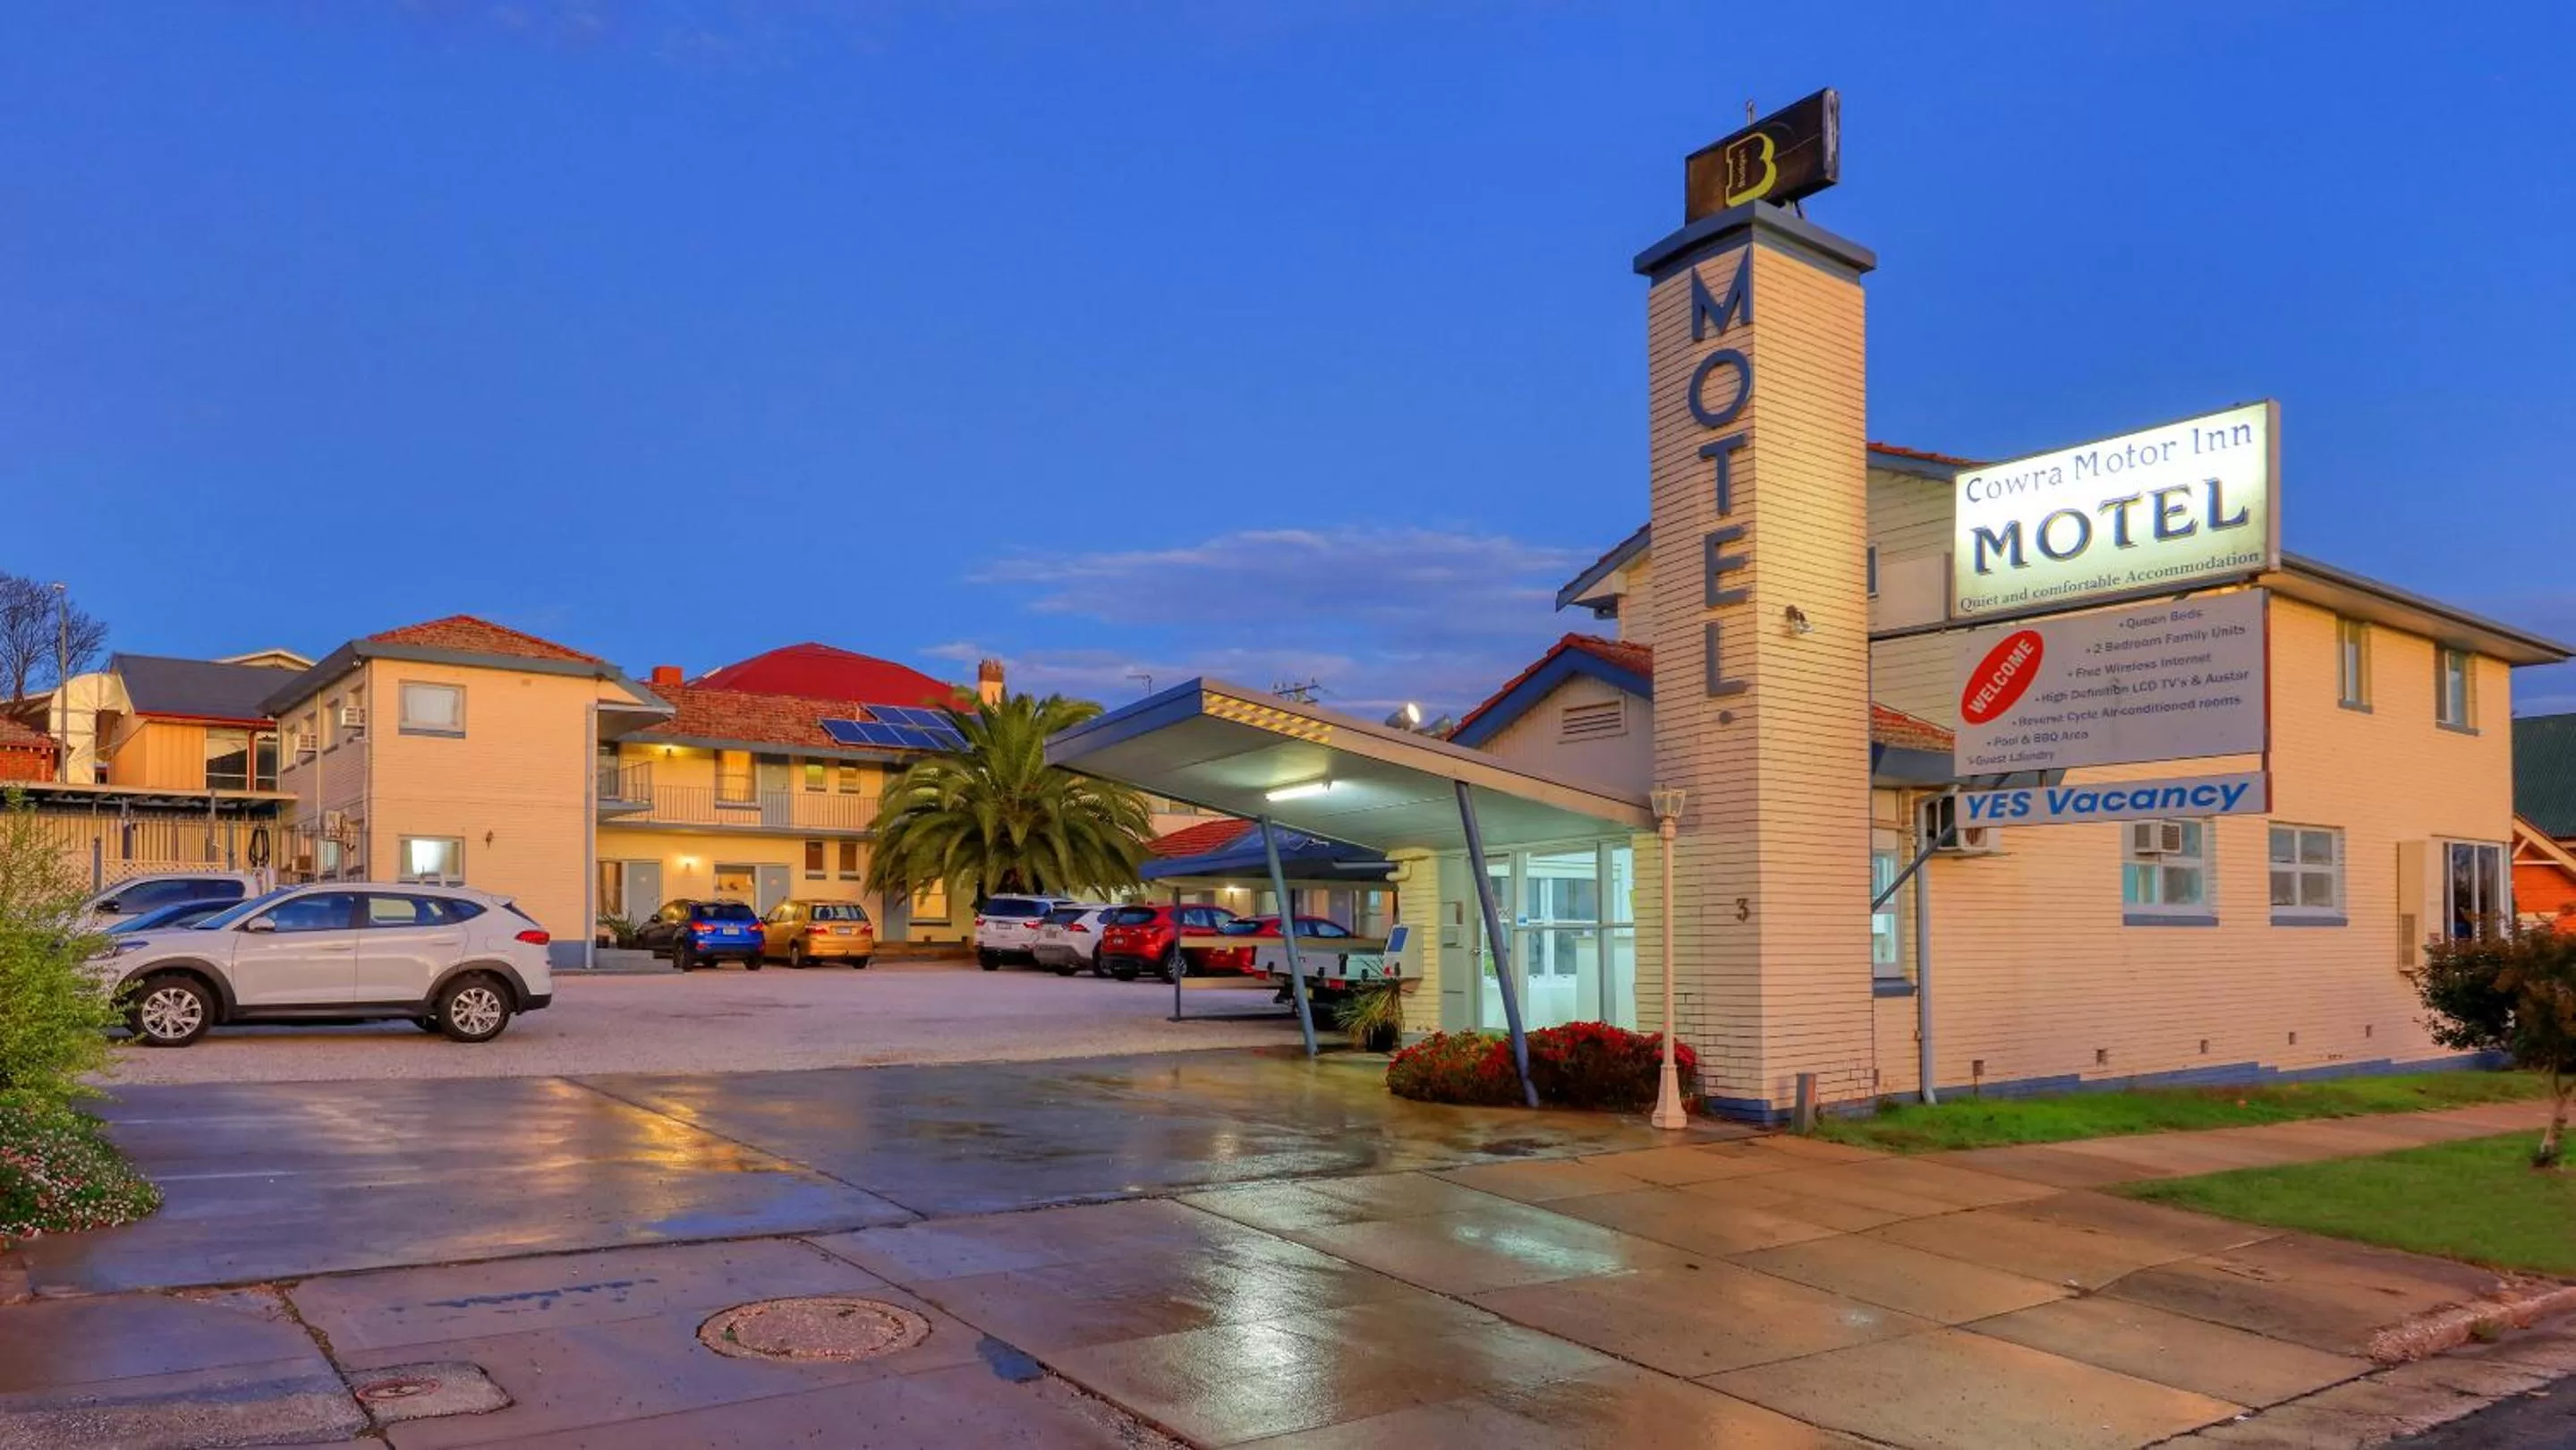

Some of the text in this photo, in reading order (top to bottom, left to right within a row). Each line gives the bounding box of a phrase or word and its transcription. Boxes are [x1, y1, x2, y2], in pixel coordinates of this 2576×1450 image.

[1688, 244, 1751, 697] MOTEL
[1967, 422, 2252, 503] Cowra Motor Inn
[1970, 477, 2250, 576] MOTEL
[1960, 551, 2259, 612] Quiet and comfortable Accommodation
[2125, 609, 2204, 629] Queen Beds
[2165, 629, 2208, 644] Family
[2211, 625, 2246, 638] Units
[1968, 638, 2034, 713] WELCOME
[2076, 652, 2211, 678] Free Wireless Internet
[2041, 692, 2069, 703] High
[2071, 684, 2129, 699] Definition
[2132, 680, 2158, 693] LCD
[2190, 674, 2201, 686] &
[2067, 711, 2097, 723] Cycle
[2199, 696, 2241, 709] rooms
[2033, 731, 2058, 743] BBQ
[2062, 729, 2088, 740] Area
[1967, 782, 2249, 820] YES Vacancy
[1736, 898, 1750, 923] 3
